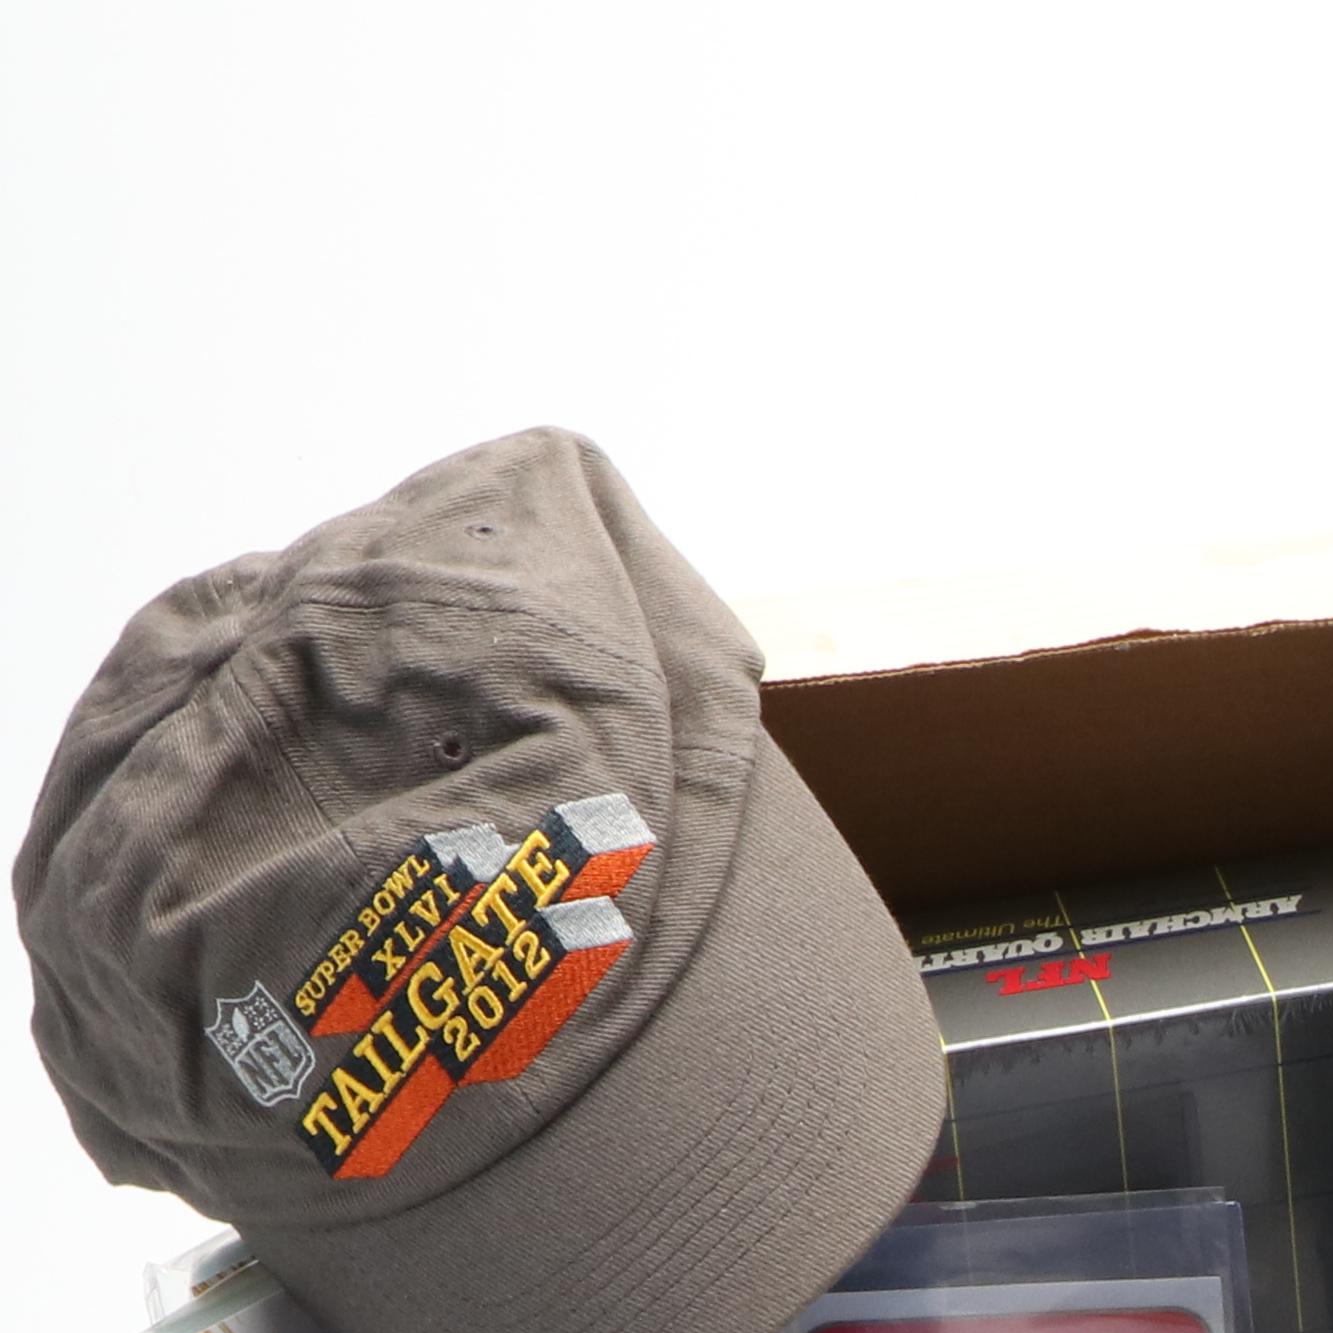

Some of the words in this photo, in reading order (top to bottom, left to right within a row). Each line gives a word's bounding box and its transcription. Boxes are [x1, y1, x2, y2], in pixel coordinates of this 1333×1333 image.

[295, 931, 366, 1016] SUPER
[365, 855, 430, 936] BOWL
[371, 873, 462, 981] XLVI
[985, 953, 1113, 996] NFL
[1081, 894, 1302, 945] ARMCHAIR
[302, 829, 571, 1157] TAILGATE
[443, 930, 551, 1062] 2012
